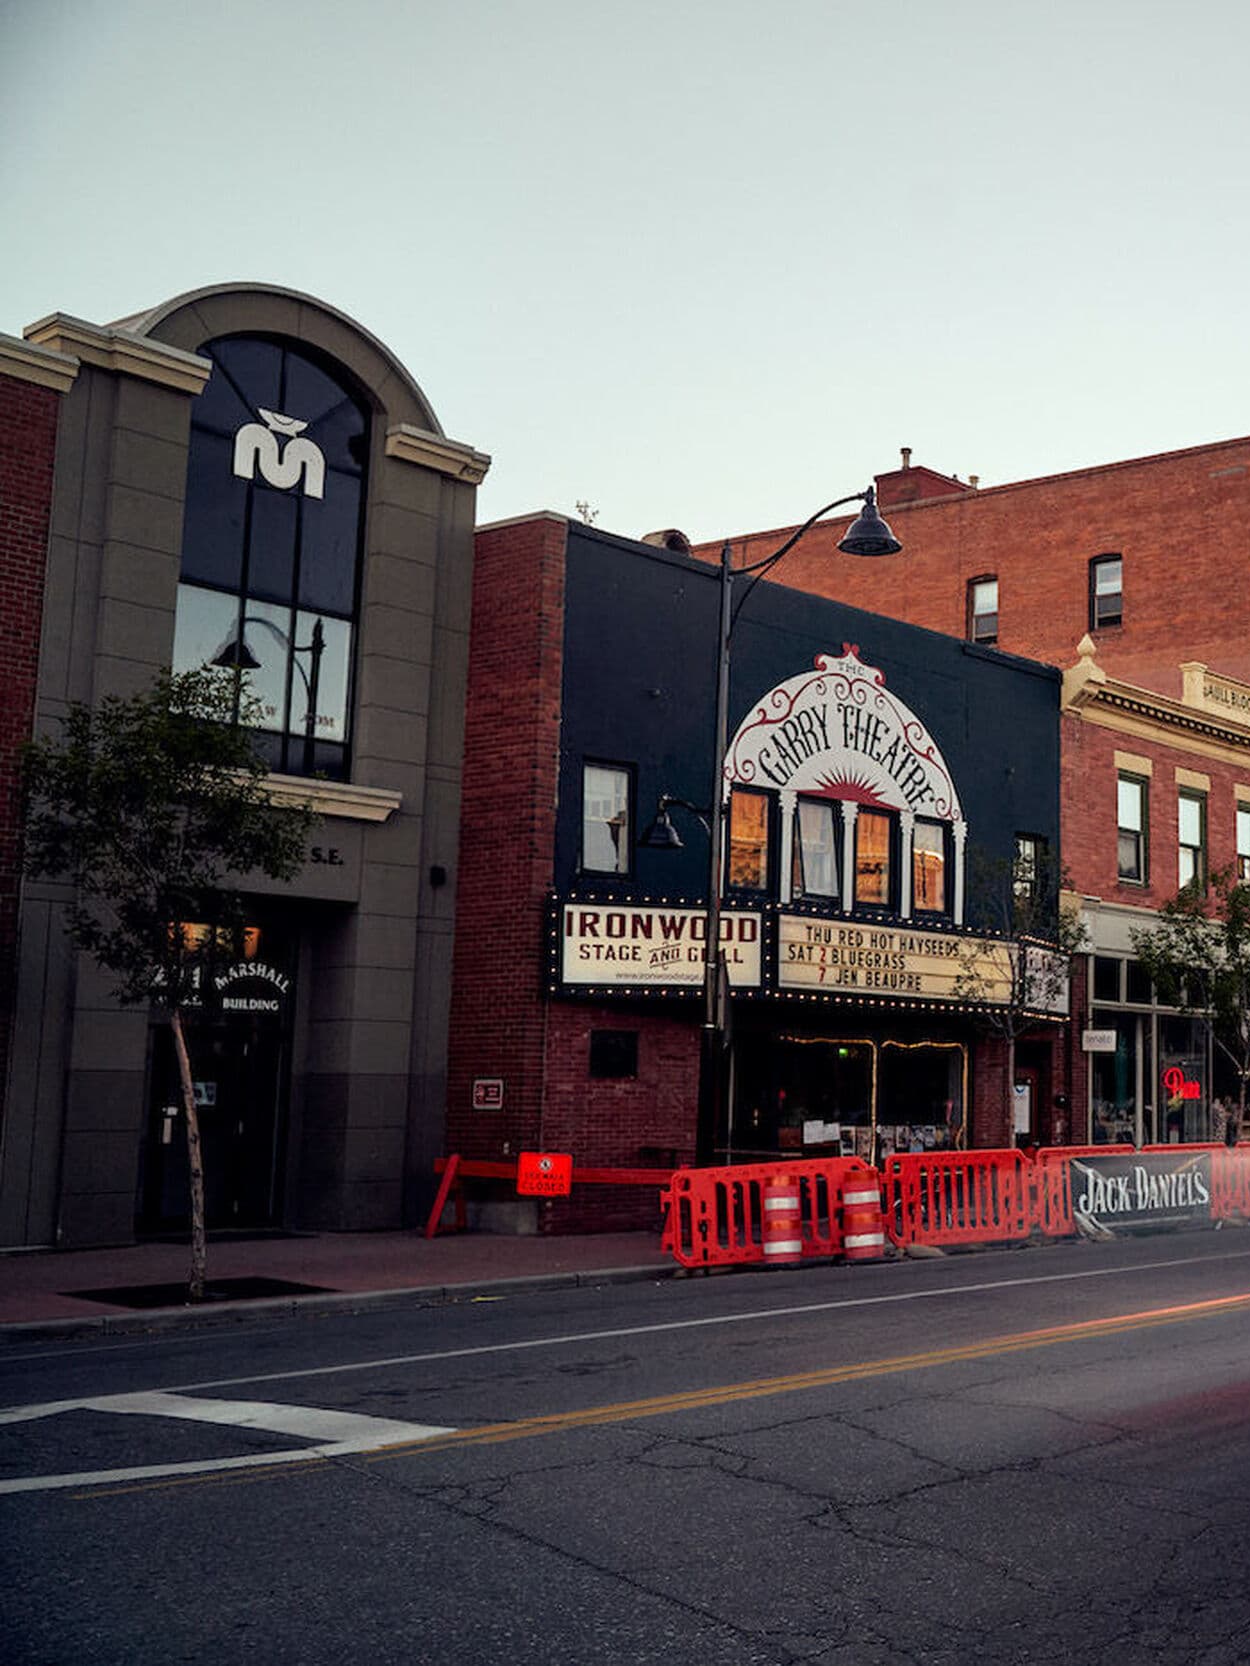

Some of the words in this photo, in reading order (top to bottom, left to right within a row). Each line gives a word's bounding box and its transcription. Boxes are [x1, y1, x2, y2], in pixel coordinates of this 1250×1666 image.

[837, 661, 865, 677] THE
[758, 703, 832, 787] GARRY
[837, 702, 936, 814] THEATRE
[311, 847, 344, 865] S.E.
[565, 910, 758, 943] IRONWOOD
[579, 944, 642, 961] STAGE
[649, 948, 681, 965] AND
[805, 926, 832, 945] THU
[838, 929, 864, 949] RED
[869, 933, 895, 952] HOT
[900, 937, 960, 957] HAYSEEDS
[788, 943, 815, 962] SAT
[818, 947, 828, 963] 2
[830, 949, 907, 970] BLUEGRASS
[214, 962, 293, 994] MARSHALL
[818, 966, 827, 983] 7
[834, 970, 859, 986] JEN
[865, 971, 922, 992] BEAUPRE
[222, 997, 279, 1012] BUILDING
[1079, 1168, 1132, 1215] JACK
[1134, 1164, 1210, 1211] DANIEL'S
